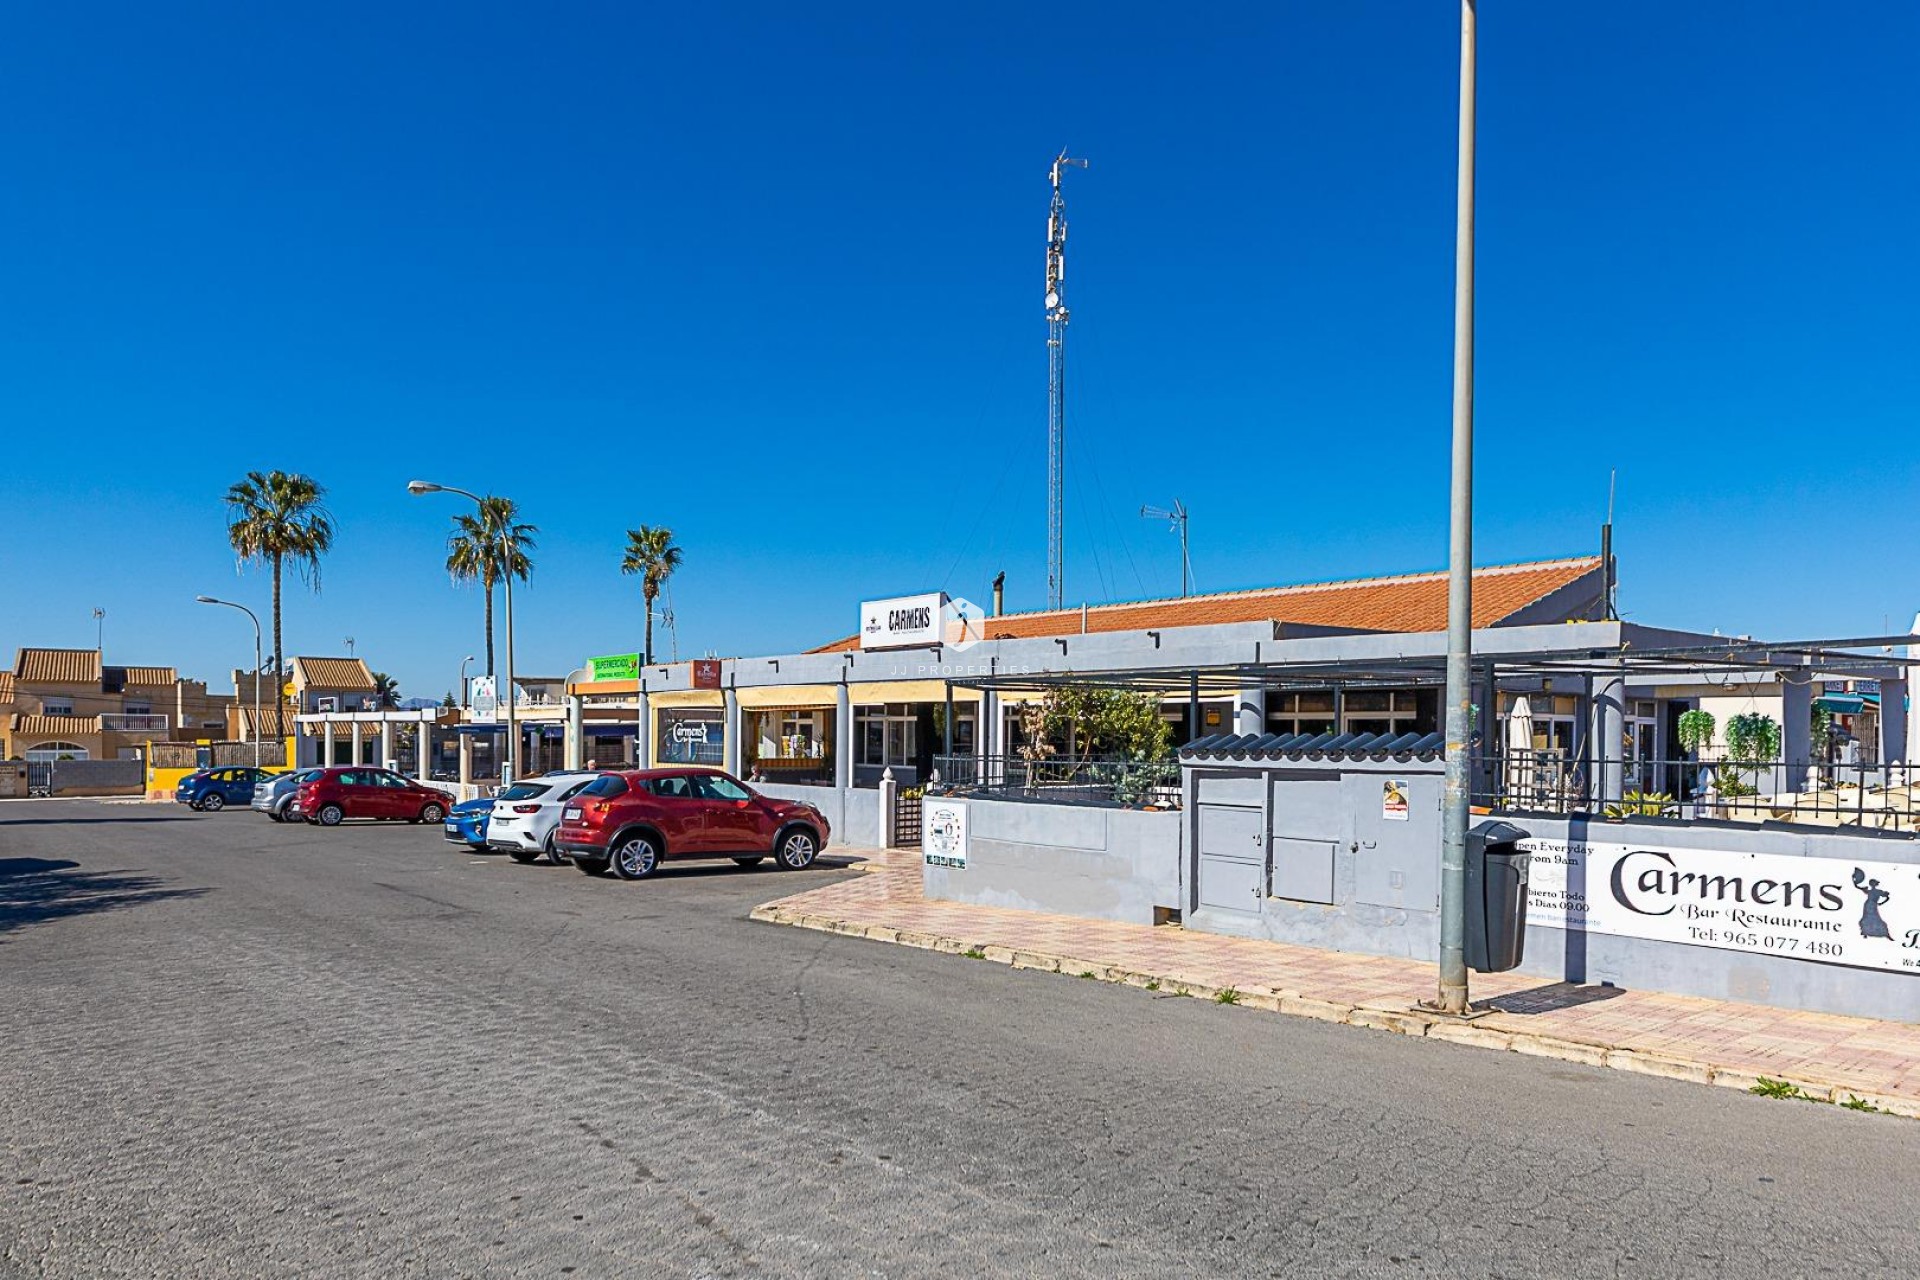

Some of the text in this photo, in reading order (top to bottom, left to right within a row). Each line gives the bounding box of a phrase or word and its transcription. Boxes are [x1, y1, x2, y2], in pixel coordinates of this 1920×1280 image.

[889, 606, 930, 632] CARMENS
[1540, 842, 1595, 856] Everyday
[1554, 855, 1579, 866] 9am
[1609, 850, 1844, 916] Carmens
[1560, 890, 1585, 901] Todo
[1559, 901, 1590, 912] 09.00
[1679, 903, 1842, 933] Bar Restaurante
[1688, 926, 1843, 957] Tel: 965 077 480
